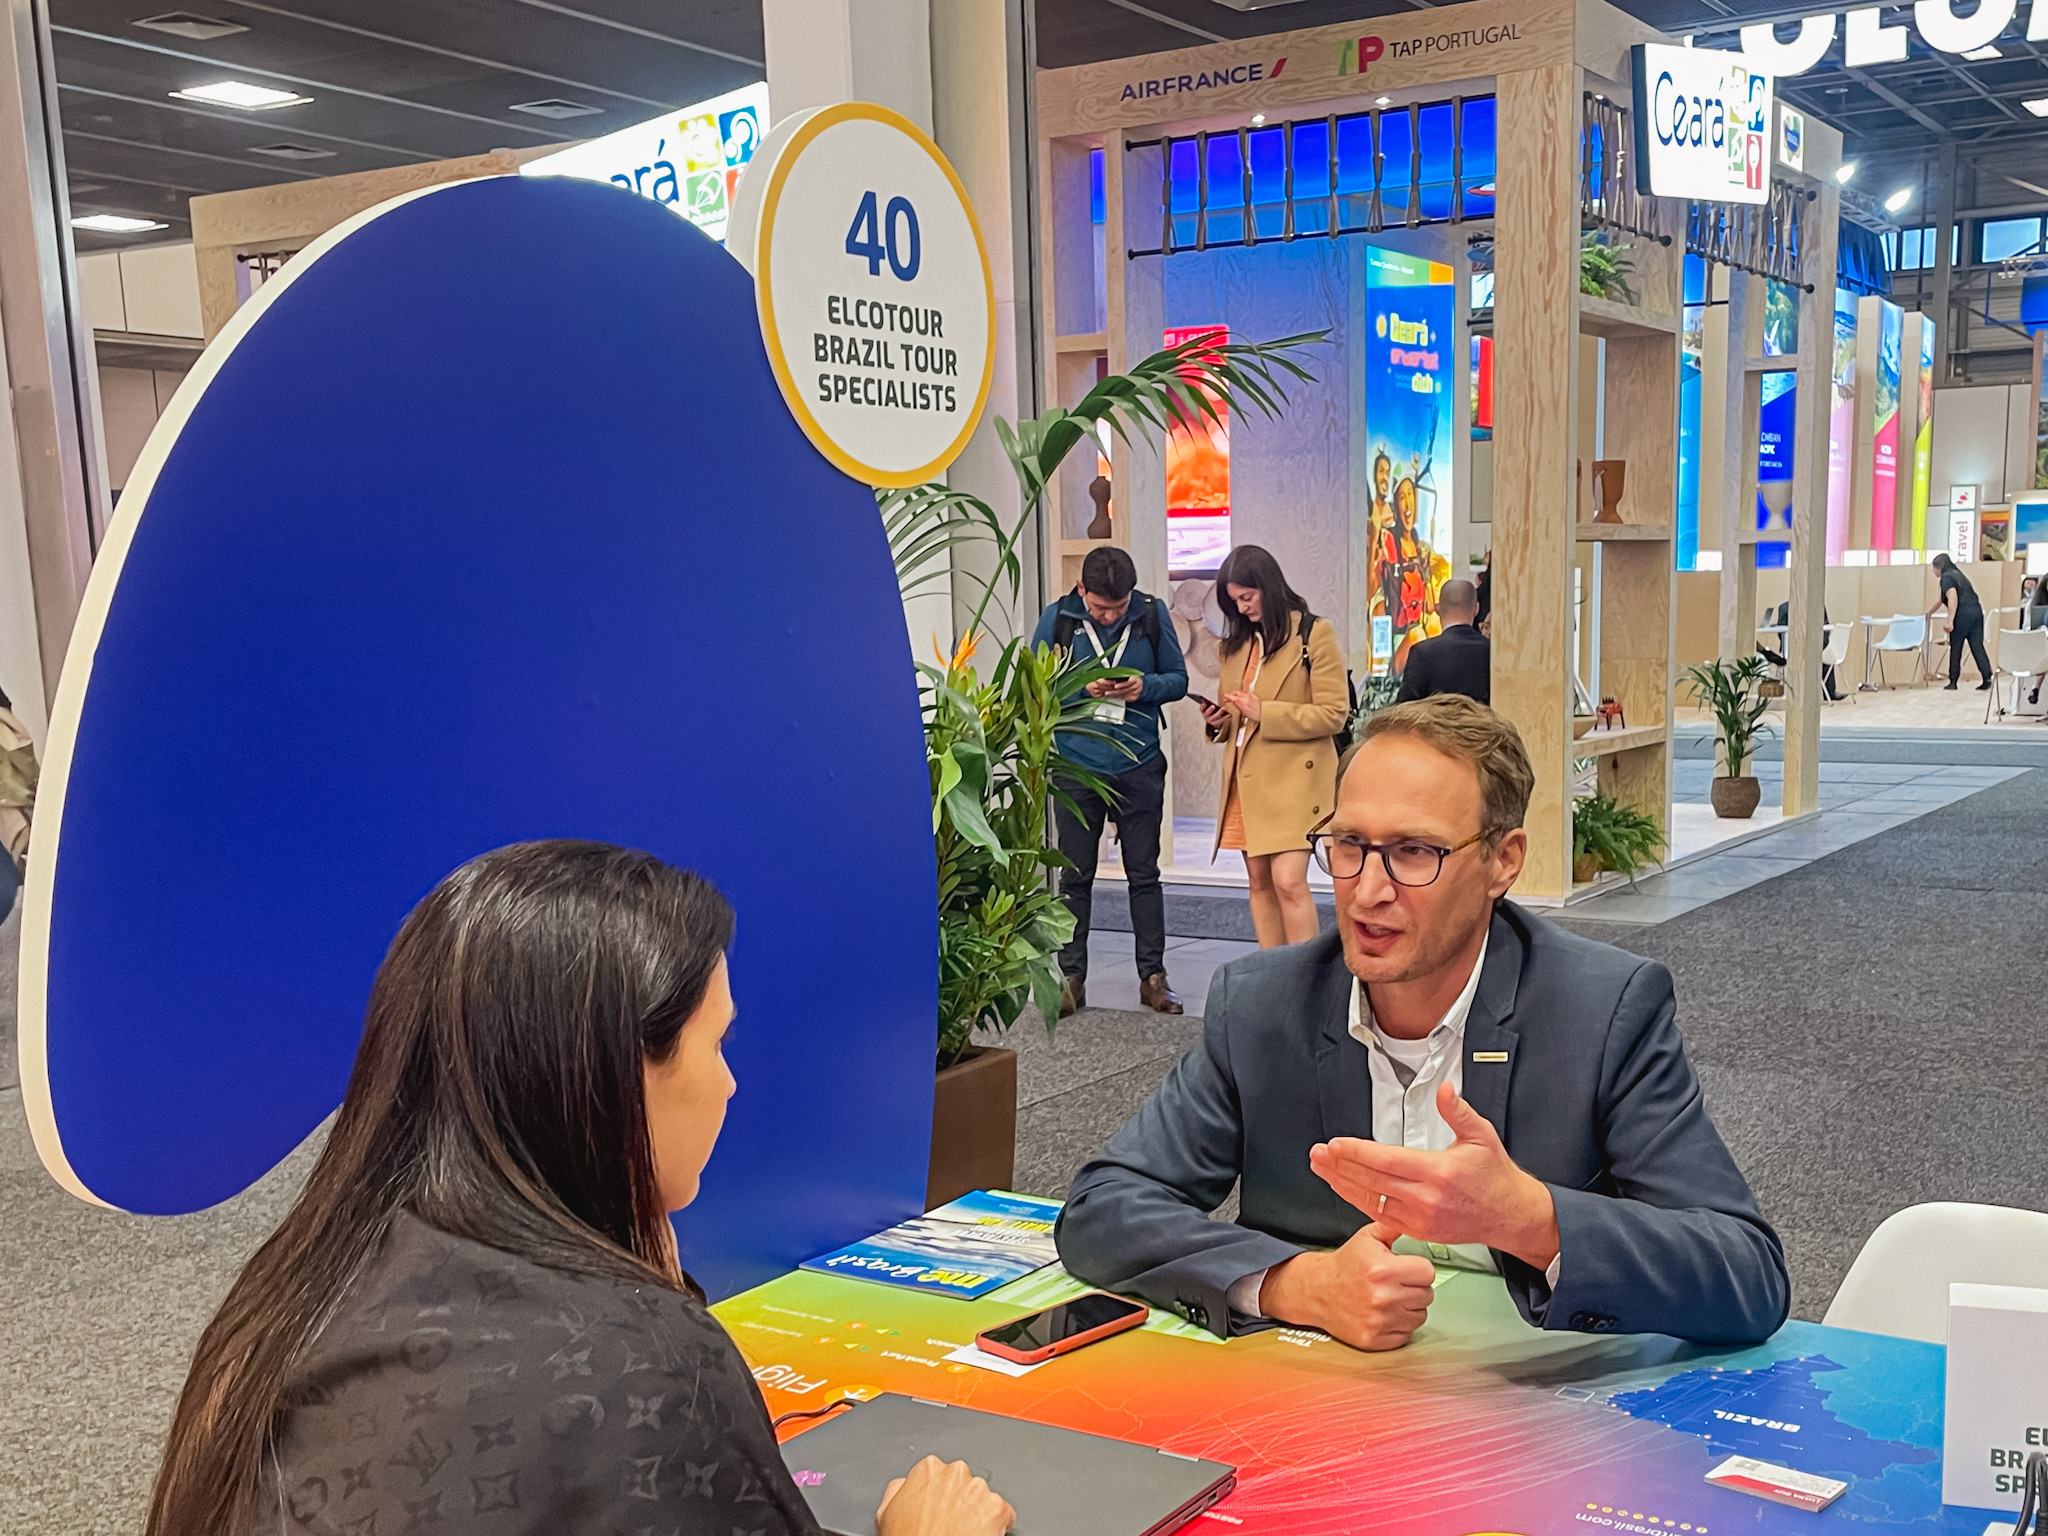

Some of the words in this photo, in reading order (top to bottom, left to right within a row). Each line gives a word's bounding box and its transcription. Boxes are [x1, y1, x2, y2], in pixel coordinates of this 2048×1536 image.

[1425, 24, 1521, 54] PORTUGAL
[1120, 62, 1263, 102] AIRFRANCE
[1655, 71, 1725, 149] Ceará
[845, 190, 921, 282] 40
[827, 295, 944, 338] ELCOTOUR
[813, 332, 895, 370] BRAZIL
[900, 343, 958, 377] TOUR
[818, 373, 957, 413] SPECIALISTS
[826, 1254, 930, 1279] Brasil
[879, 1350, 941, 1368] Frankfurt
[926, 1338, 965, 1350] unich
[1712, 1408, 1801, 1434] BRAZIL
